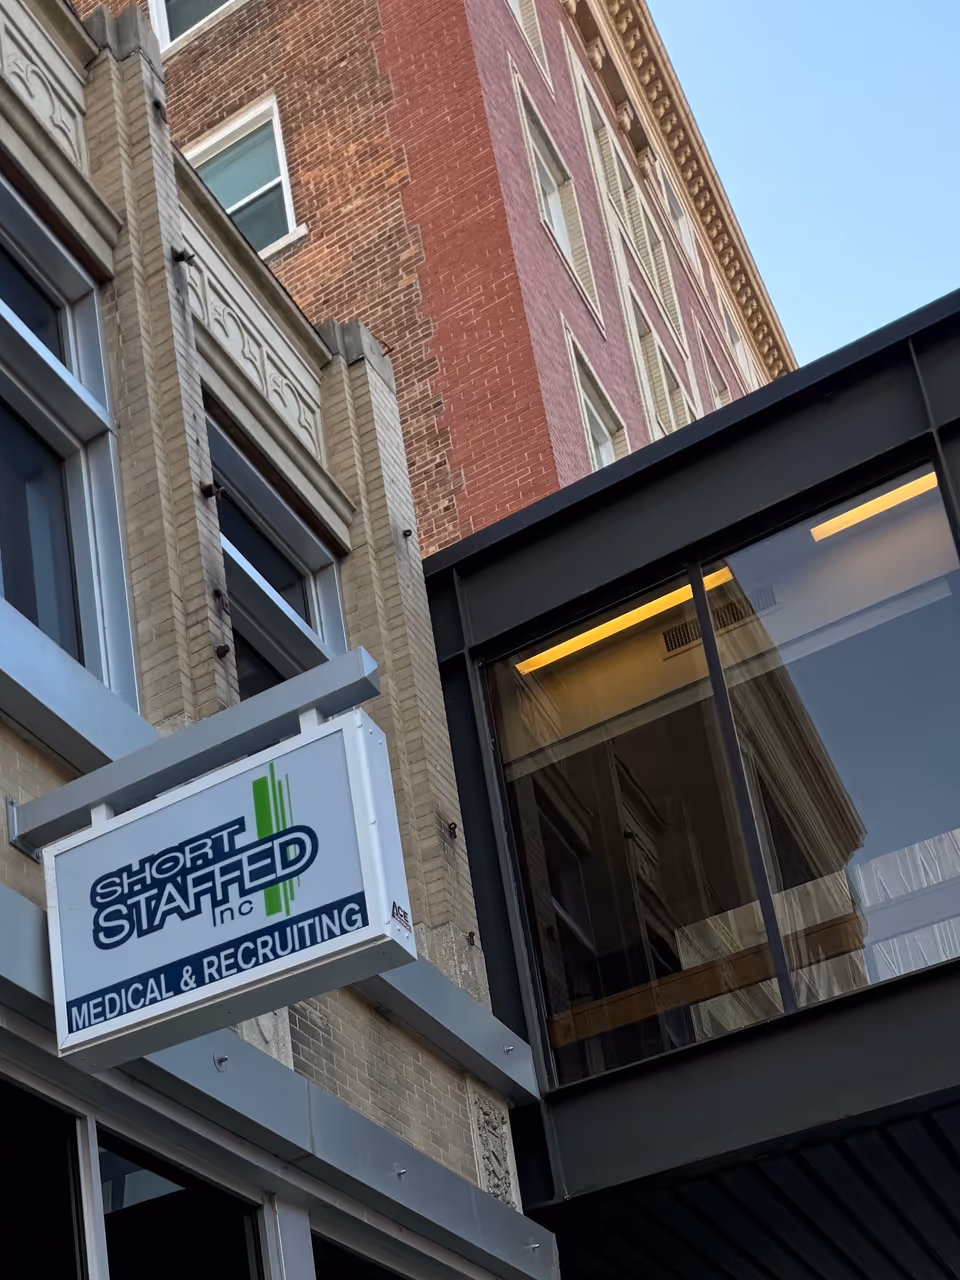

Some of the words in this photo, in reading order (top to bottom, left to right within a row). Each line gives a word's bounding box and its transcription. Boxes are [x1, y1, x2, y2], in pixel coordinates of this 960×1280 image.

[95, 824, 240, 904] SHORT
[97, 830, 313, 946] STAFFED
[71, 976, 174, 1032] MEDICAL
[180, 965, 197, 989] &
[203, 903, 363, 984] RECRUITING
